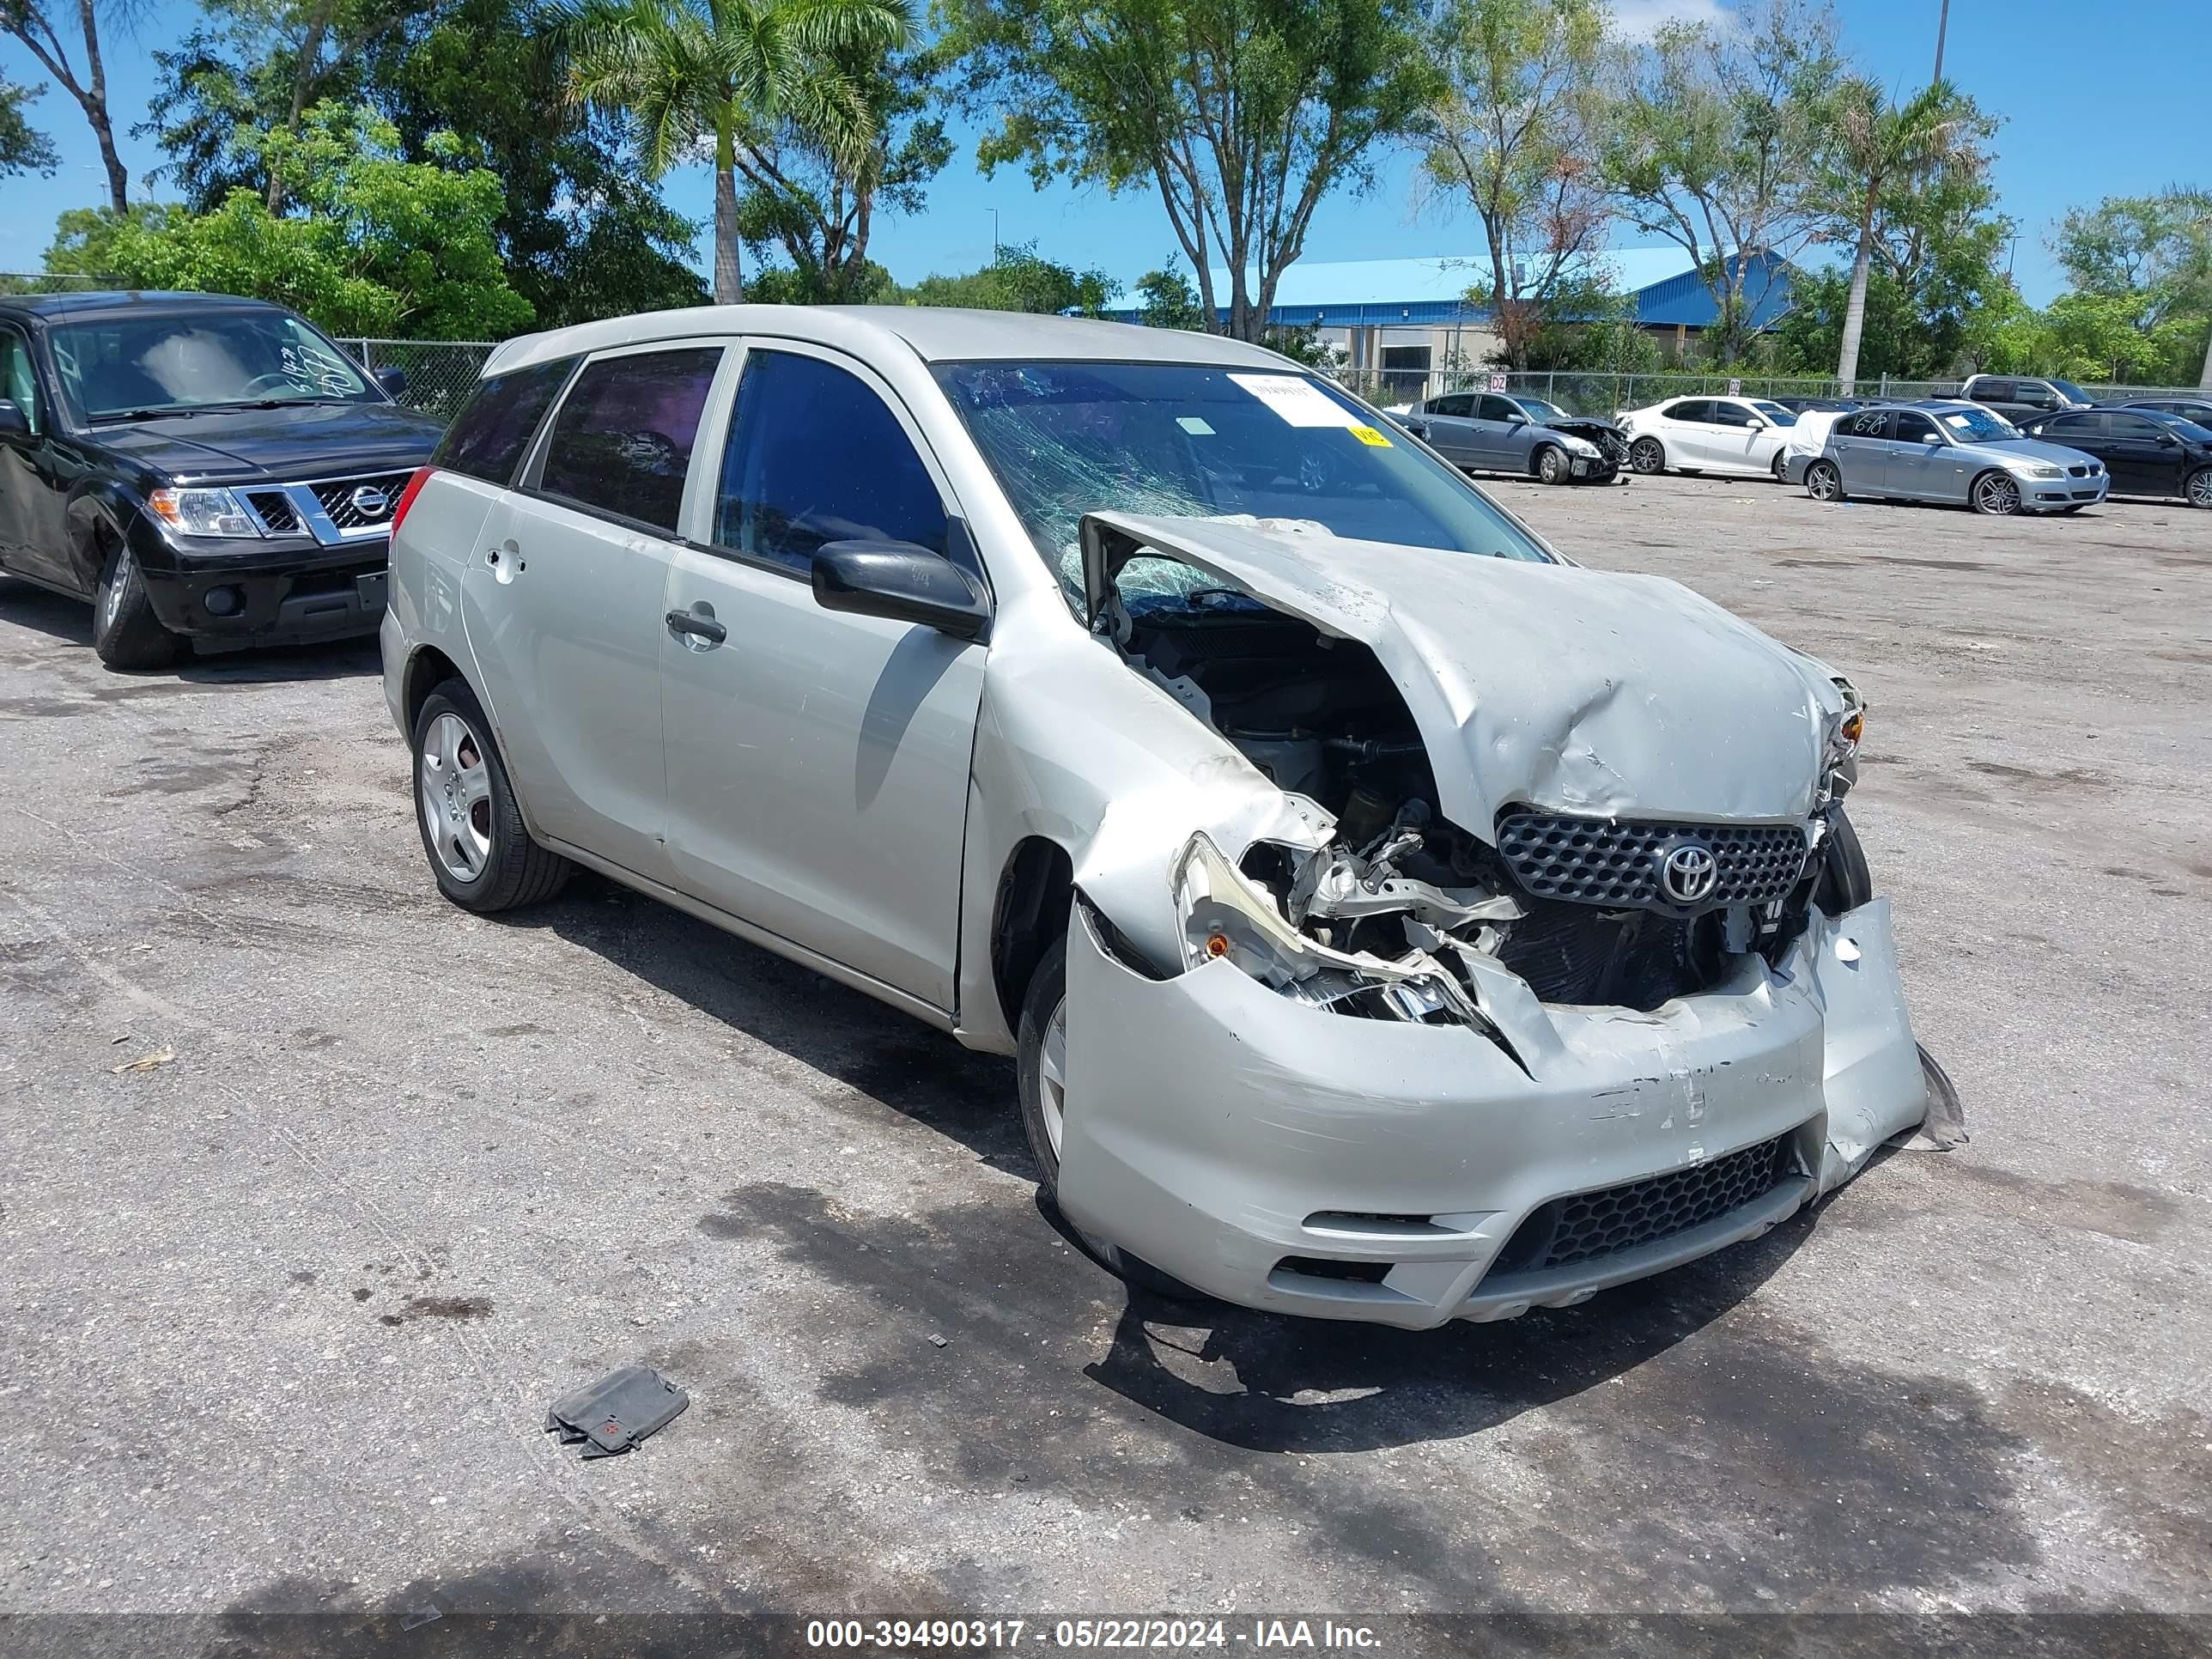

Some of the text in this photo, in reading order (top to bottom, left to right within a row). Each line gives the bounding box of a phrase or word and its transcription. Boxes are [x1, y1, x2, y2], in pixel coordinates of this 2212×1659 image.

[297, 345, 358, 398] 4077
[1492, 376, 1505, 389] DZ
[1854, 412, 1887, 435] 6-18
